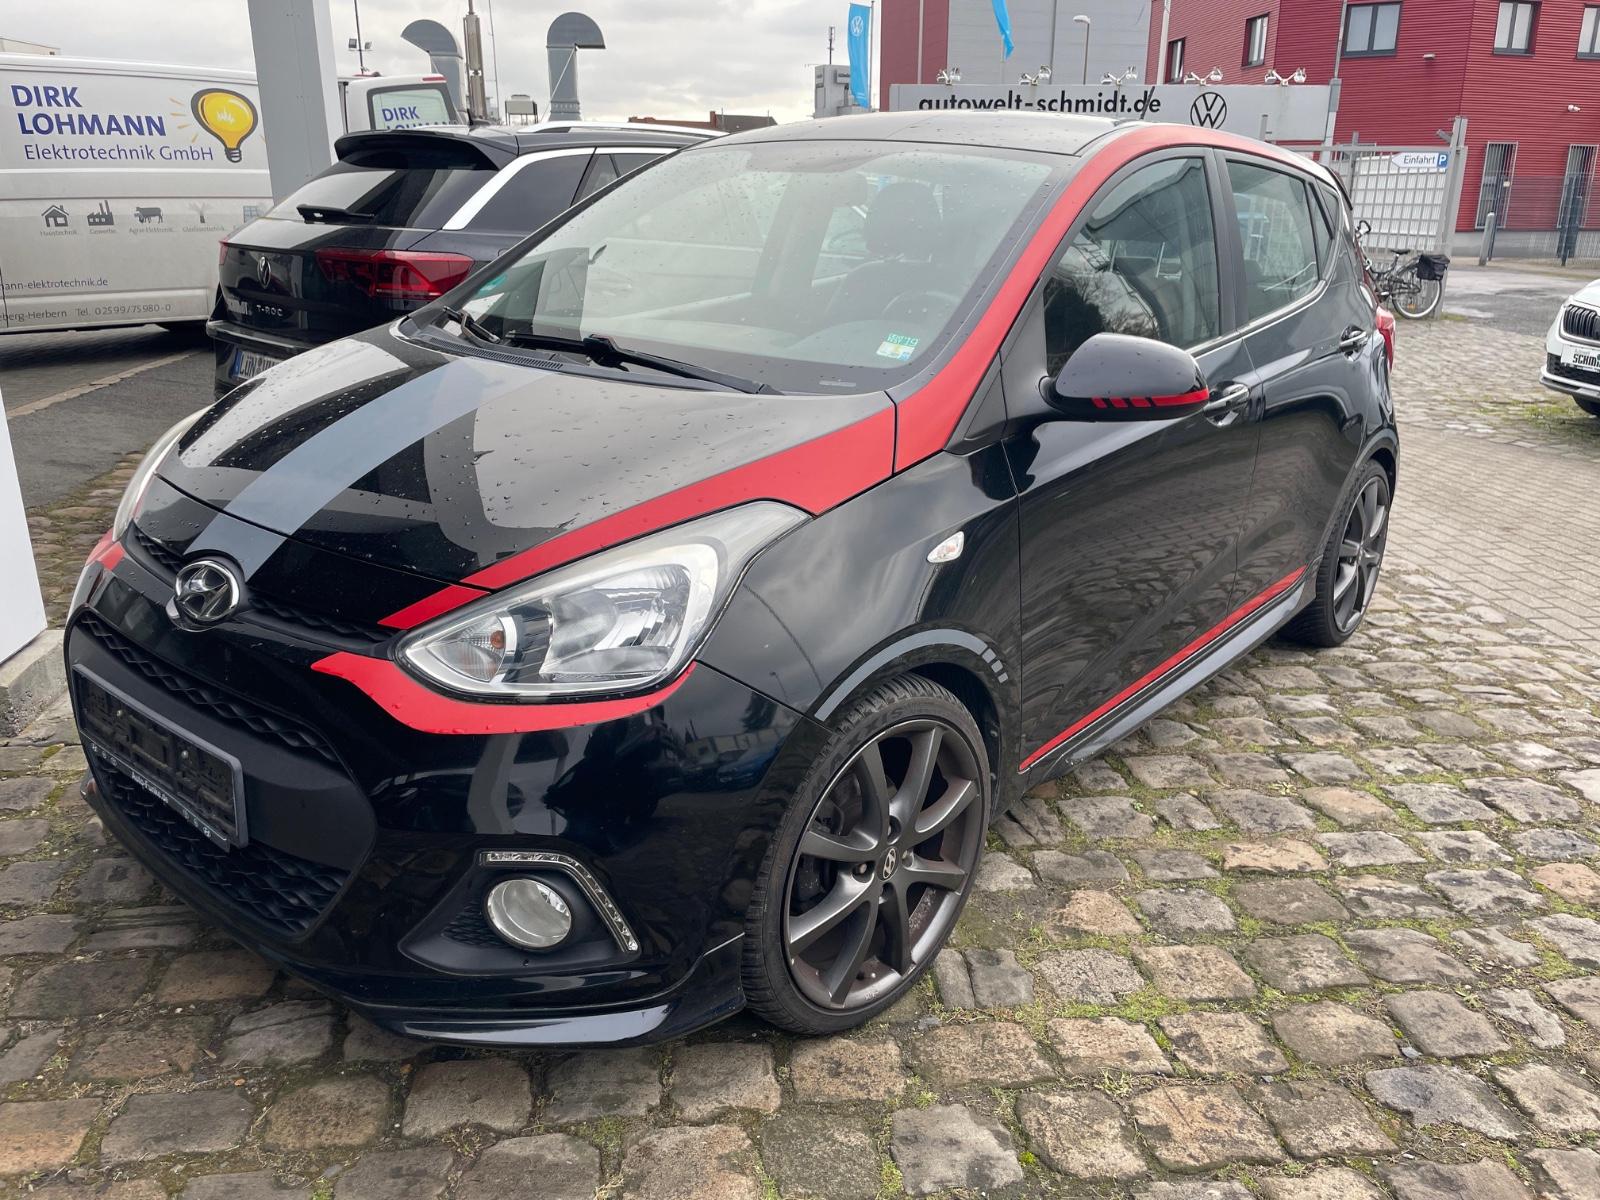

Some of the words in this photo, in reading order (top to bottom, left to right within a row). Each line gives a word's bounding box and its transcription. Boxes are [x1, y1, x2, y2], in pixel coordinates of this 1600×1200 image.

[11, 85, 82, 108] DIRK
[918, 89, 1161, 113] autowelt-schmidt.de
[382, 106, 420, 122] DIRK
[18, 112, 167, 137] LOHMANN
[24, 144, 156, 161] Elektrotechnik
[159, 145, 214, 161] GmbH
[1403, 155, 1436, 165] Einfahrt
[1438, 154, 1447, 166] P
[0, 278, 108, 290] ann-elektrotechnik.de
